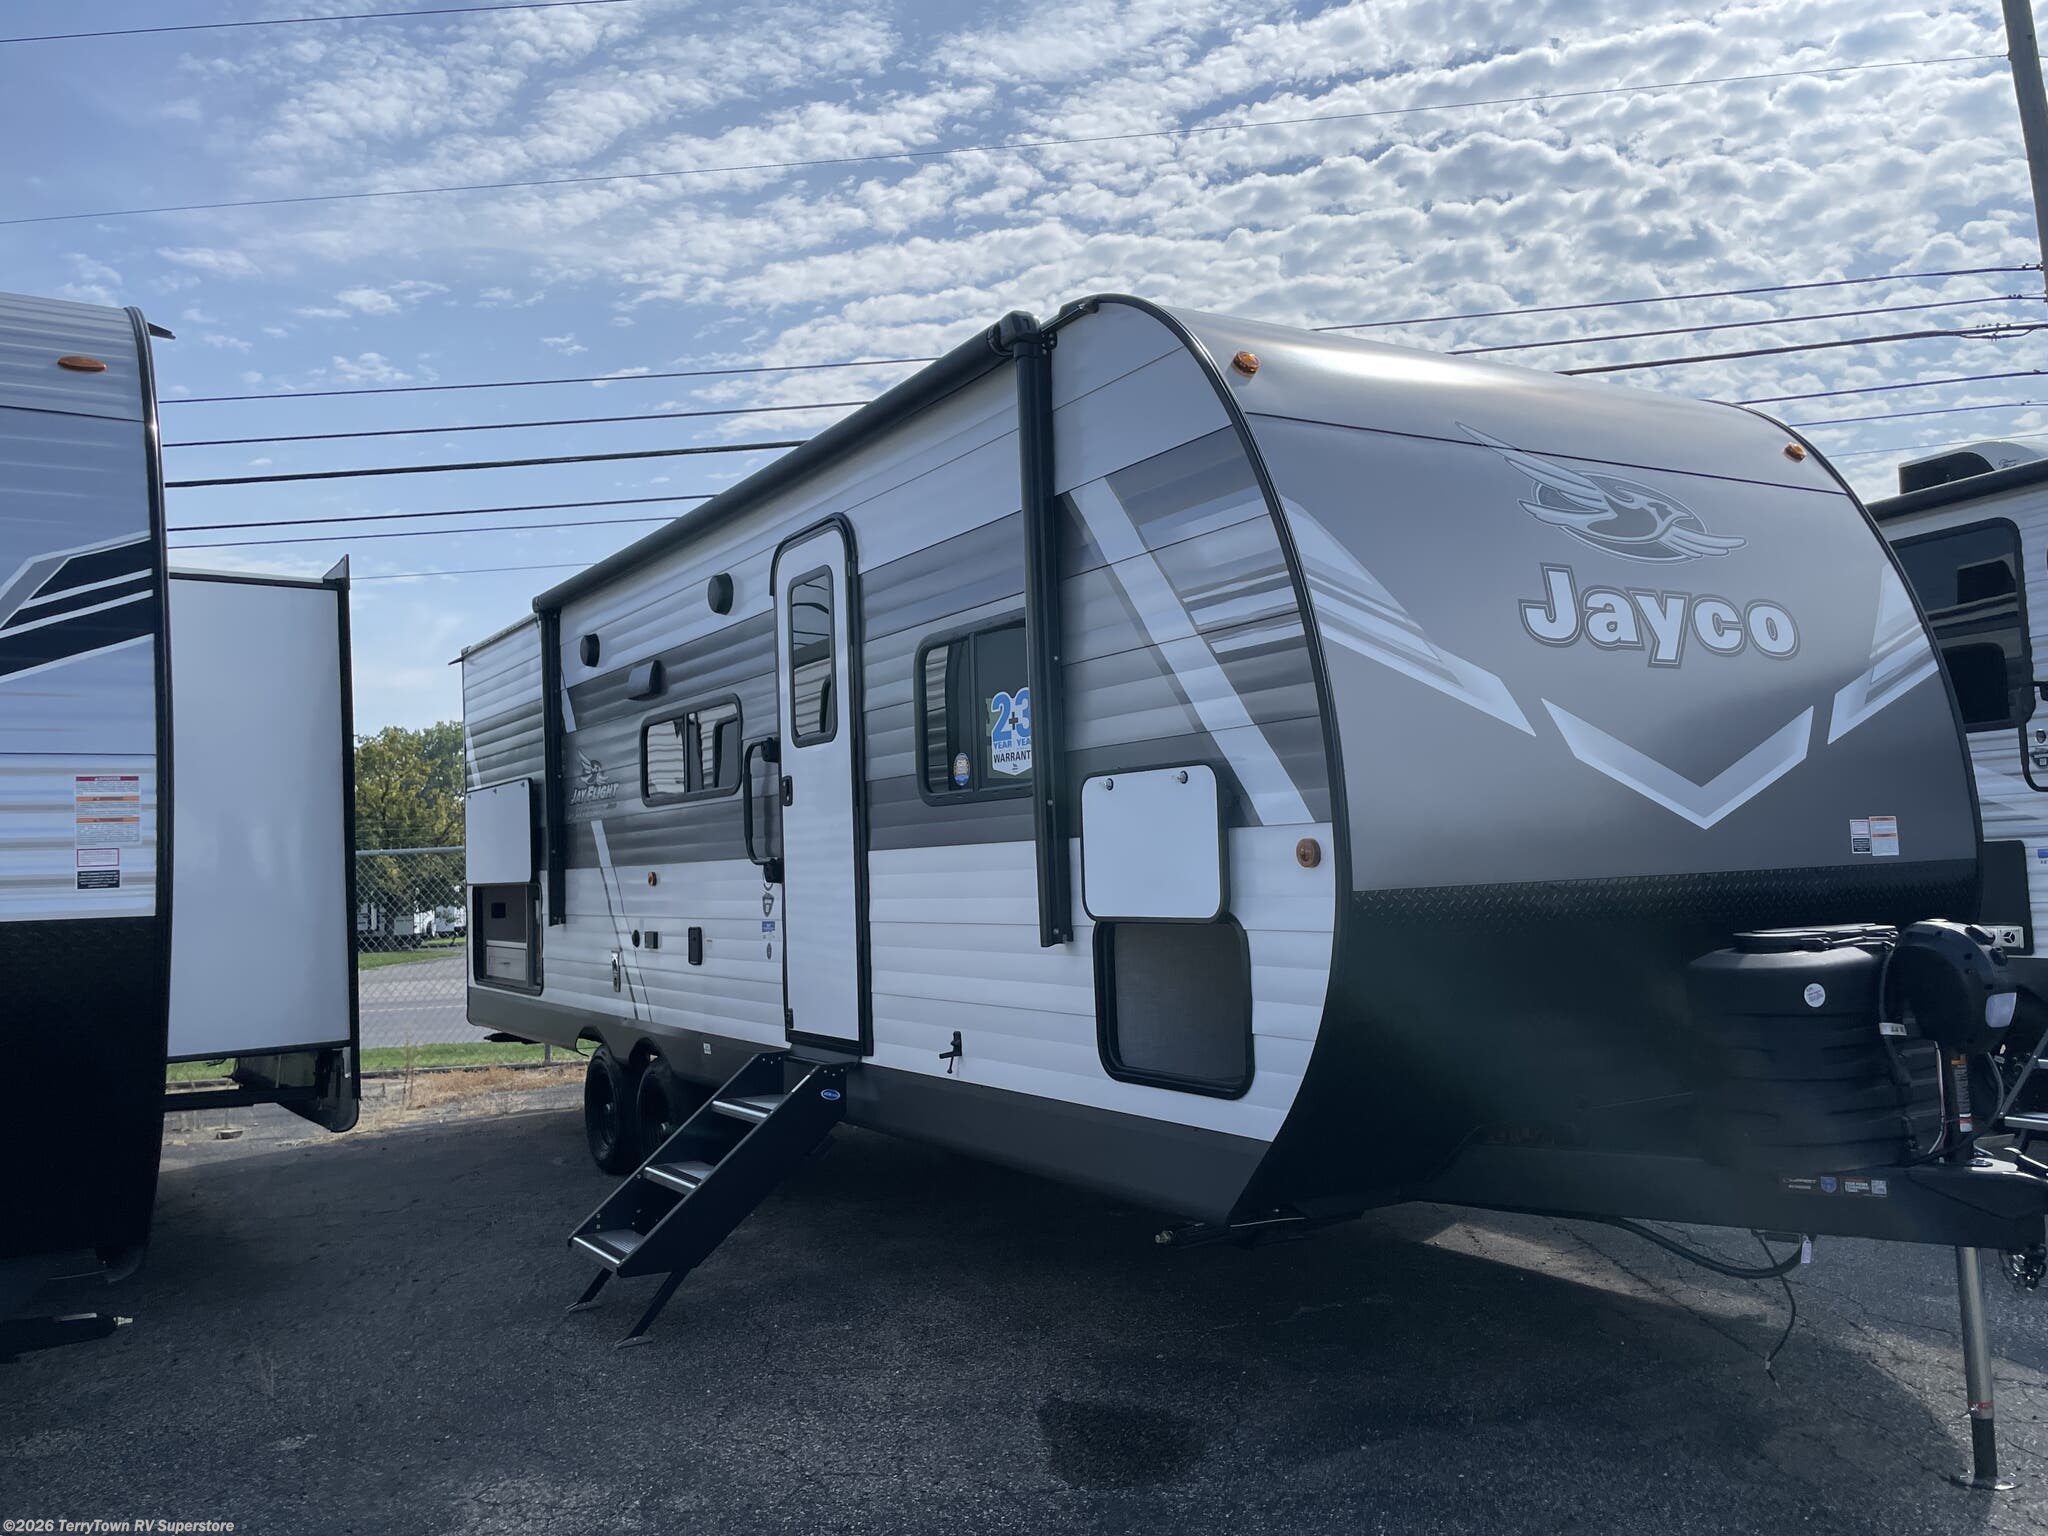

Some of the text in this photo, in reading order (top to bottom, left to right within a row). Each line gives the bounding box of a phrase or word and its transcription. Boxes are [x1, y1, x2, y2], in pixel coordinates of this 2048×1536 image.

[1518, 563, 1799, 669] Jayco
[993, 738, 1031, 749] YEAR YEA
[994, 750, 1031, 763] WARRANT
